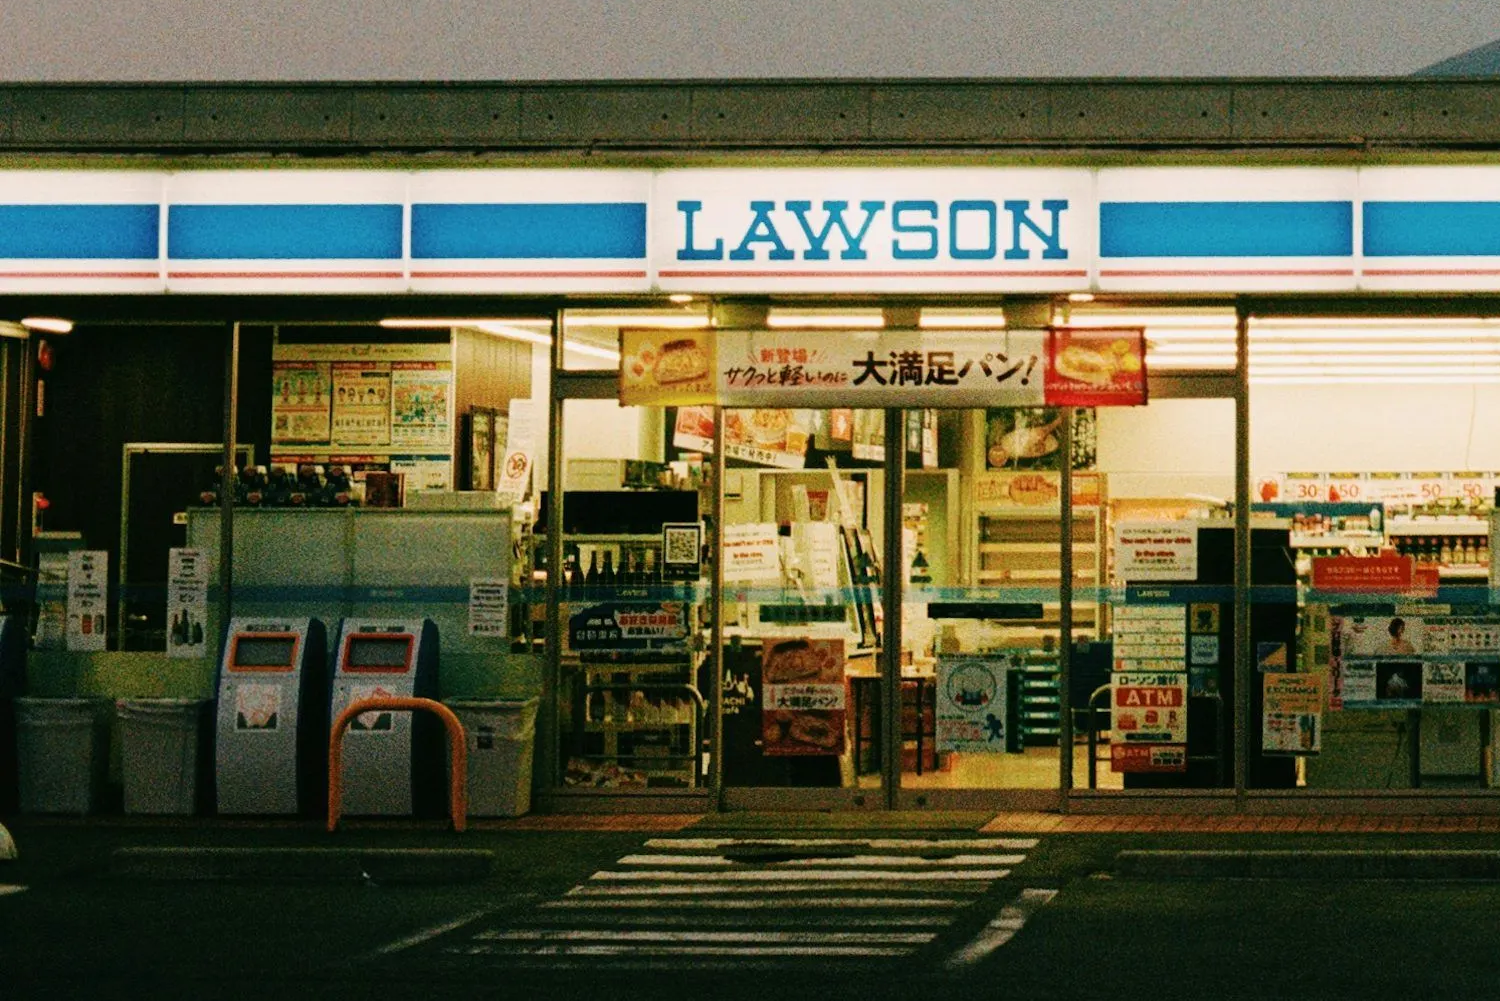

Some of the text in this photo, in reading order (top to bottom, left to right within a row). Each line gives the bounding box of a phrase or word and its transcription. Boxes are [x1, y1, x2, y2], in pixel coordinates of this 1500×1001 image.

[677, 200, 1068, 260] LAWSON
[853, 351, 1037, 386] 大満足パン!
[1126, 689, 1173, 705] ATM
